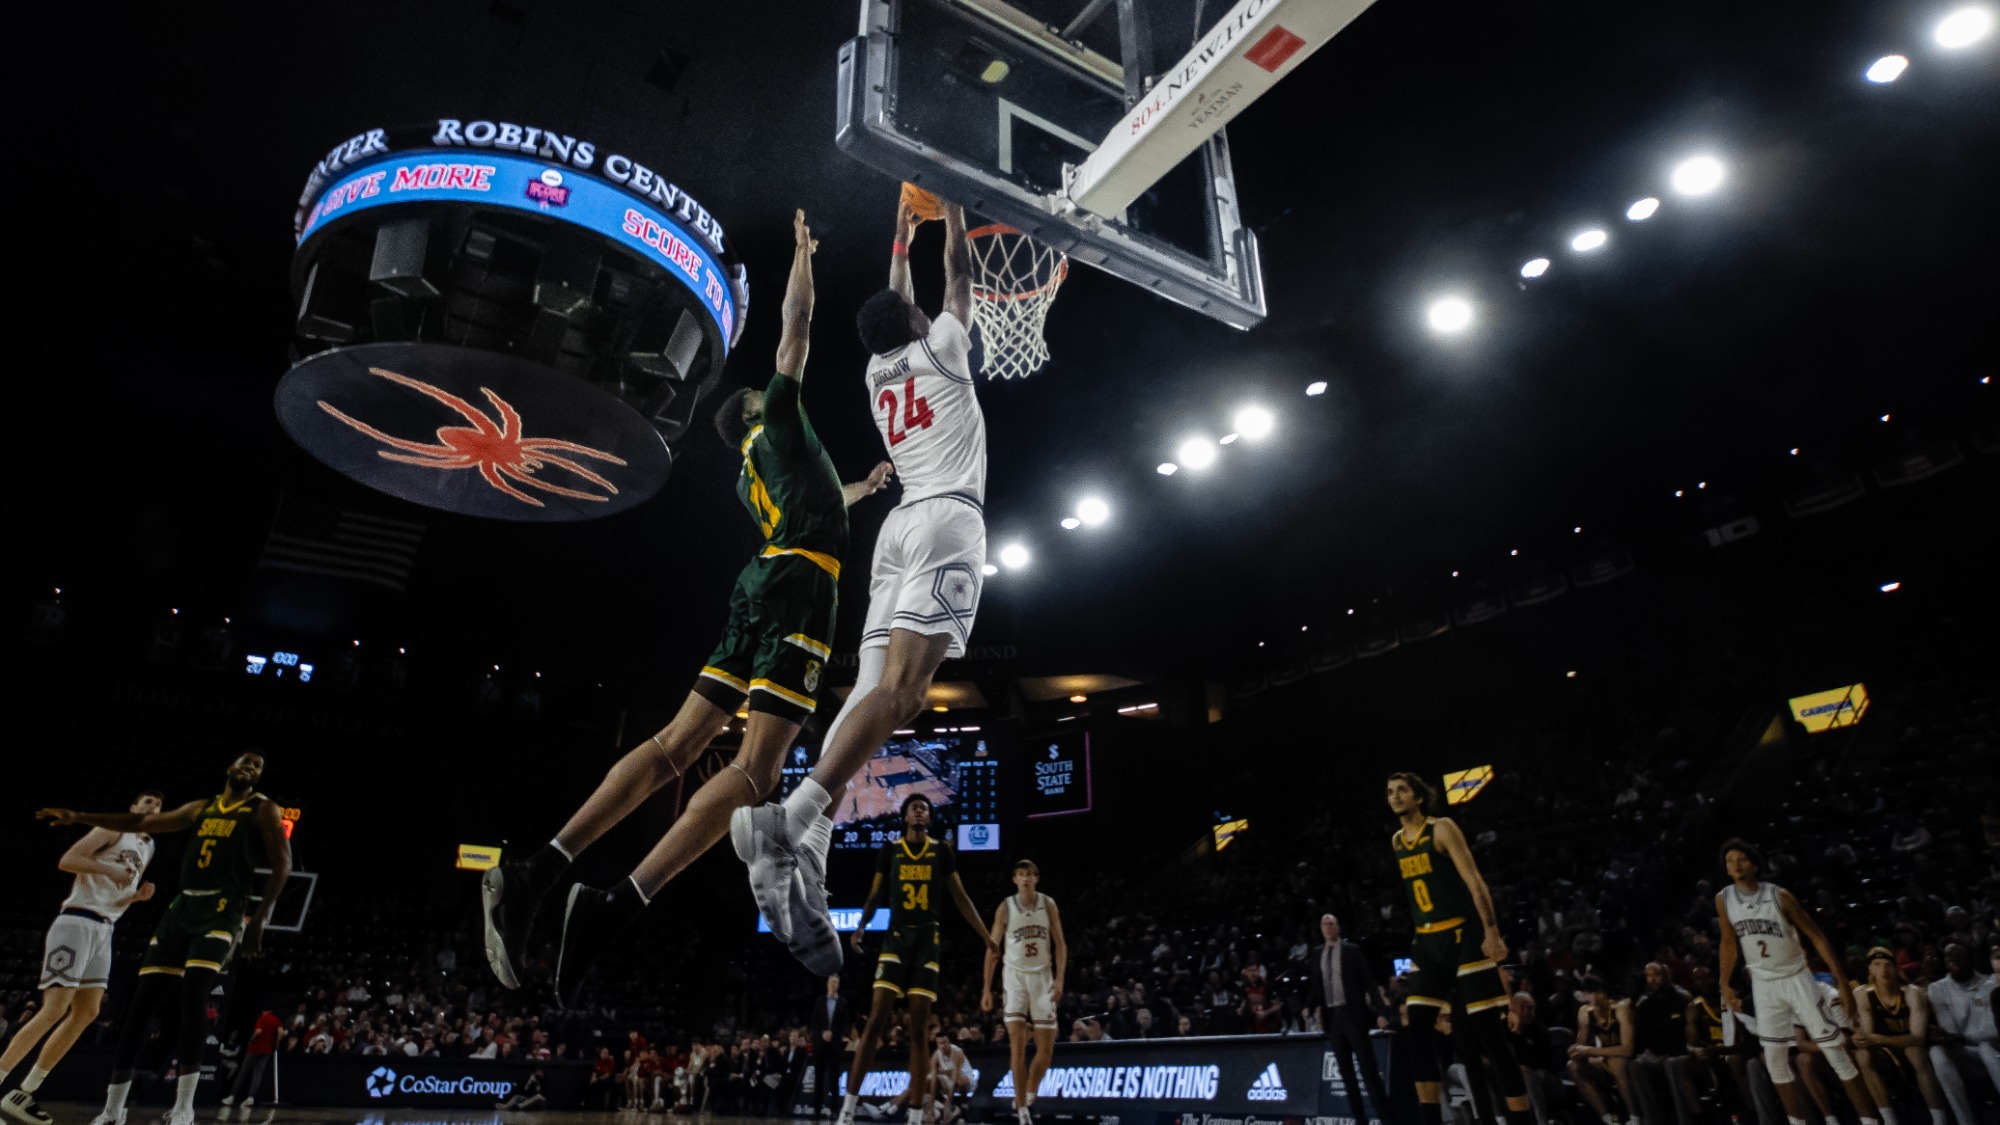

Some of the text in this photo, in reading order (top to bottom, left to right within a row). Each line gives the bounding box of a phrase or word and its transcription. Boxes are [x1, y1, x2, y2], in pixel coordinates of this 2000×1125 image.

[390, 163, 496, 193] MORE
[432, 118, 725, 254] ROBINS CENTER
[622, 209, 703, 282] SCORE
[706, 268, 724, 311] TO
[878, 376, 935, 447] 24
[1035, 760, 1073, 776] SOUTH
[1037, 773, 1072, 790] STATE
[844, 831, 859, 842] 20
[198, 839, 217, 869] 5
[1399, 852, 1433, 879] SIENA
[899, 864, 932, 880] SIENA
[902, 883, 928, 910] 34
[1412, 879, 1434, 912] 0
[1734, 918, 1783, 938] SPIDERS
[1025, 942, 1038, 957] 35
[1757, 940, 1770, 958] 2
[1121, 1066, 1142, 1098] IS
[1140, 1065, 1220, 1100] NOTHING
[1247, 1088, 1288, 1101] adidas
